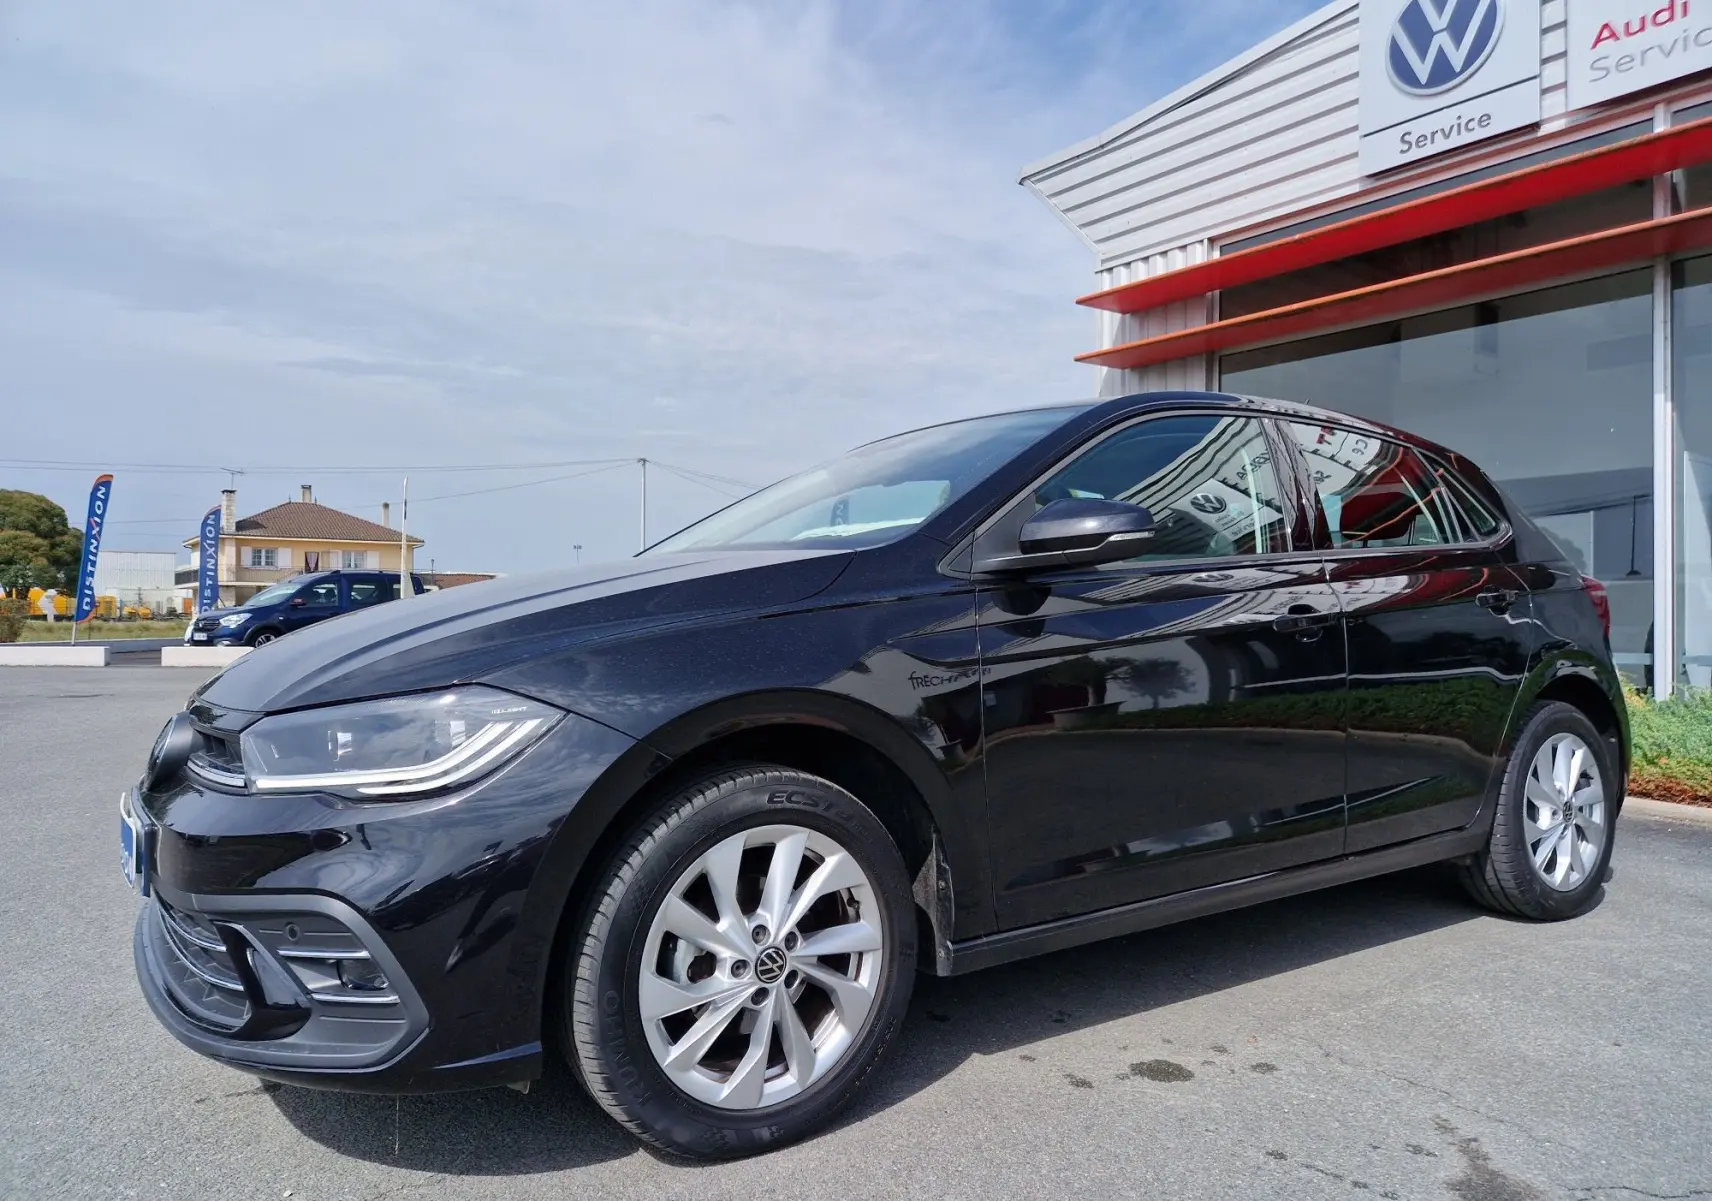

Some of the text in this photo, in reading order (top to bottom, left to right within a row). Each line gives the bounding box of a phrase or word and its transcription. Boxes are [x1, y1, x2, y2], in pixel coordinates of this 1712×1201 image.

[1590, 0, 1689, 50] Audi
[1398, 112, 1492, 155] Service
[81, 484, 107, 611] DISTINXION
